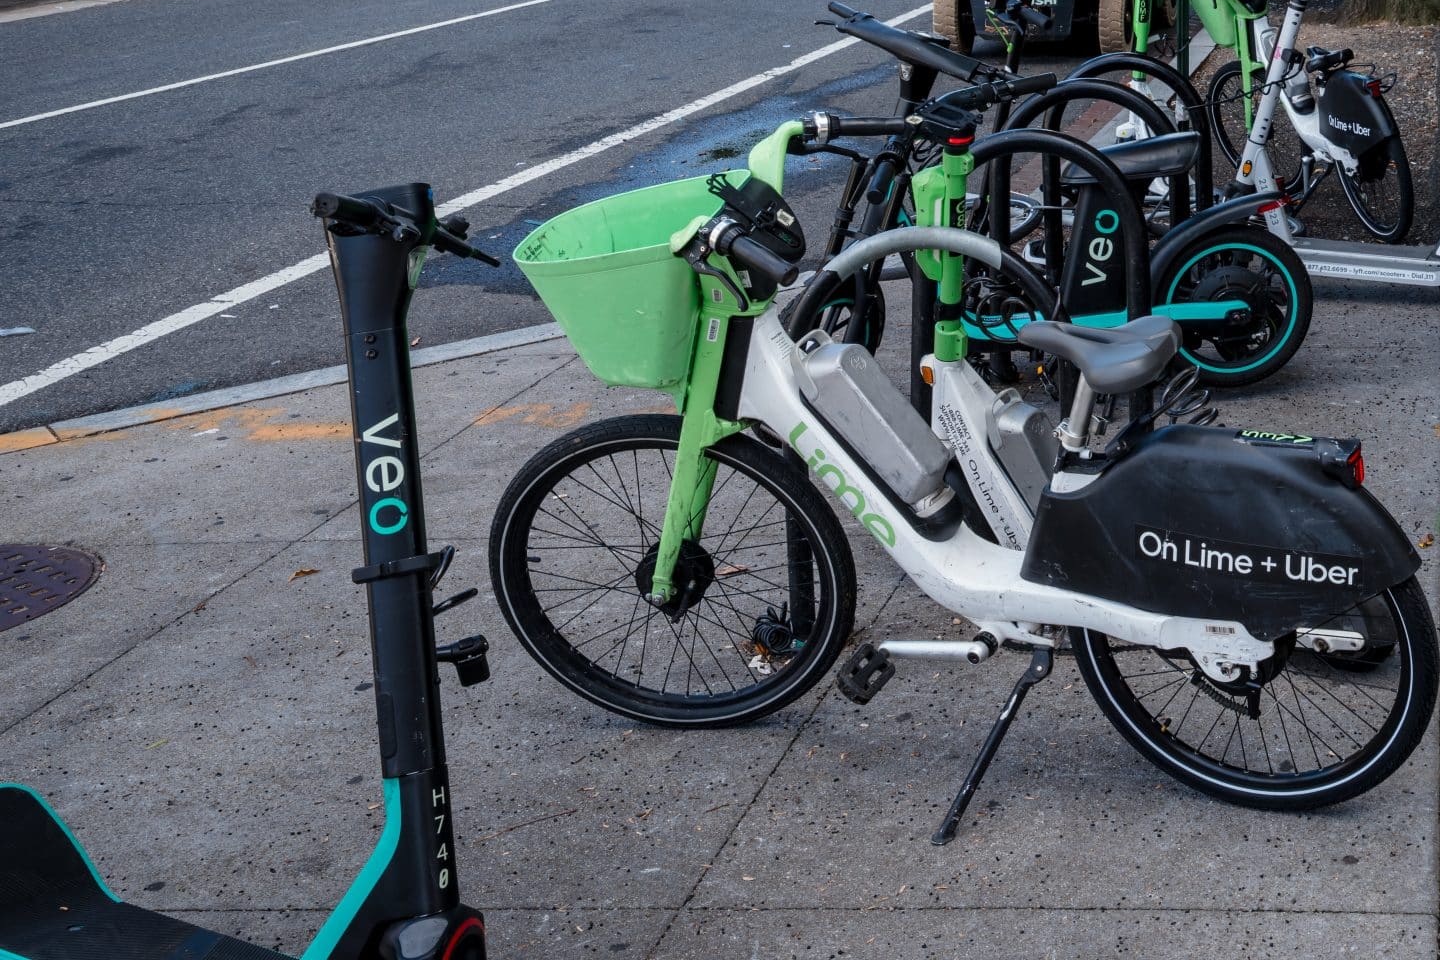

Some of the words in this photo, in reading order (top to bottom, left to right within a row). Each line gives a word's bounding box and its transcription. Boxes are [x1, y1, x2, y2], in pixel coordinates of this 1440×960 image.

[1334, 117, 1348, 132] Lime
[1352, 122, 1370, 137] Uber
[1081, 209, 1119, 286] veo
[363, 412, 409, 535] veo
[789, 421, 896, 548] Lime
[968, 459, 981, 481] On
[978, 481, 999, 514] Lime
[1003, 526, 1022, 551] Ube
[1139, 531, 1178, 562] On
[1184, 539, 1253, 574] Lime
[1260, 556, 1277, 572] +
[1285, 554, 1358, 585] Uber
